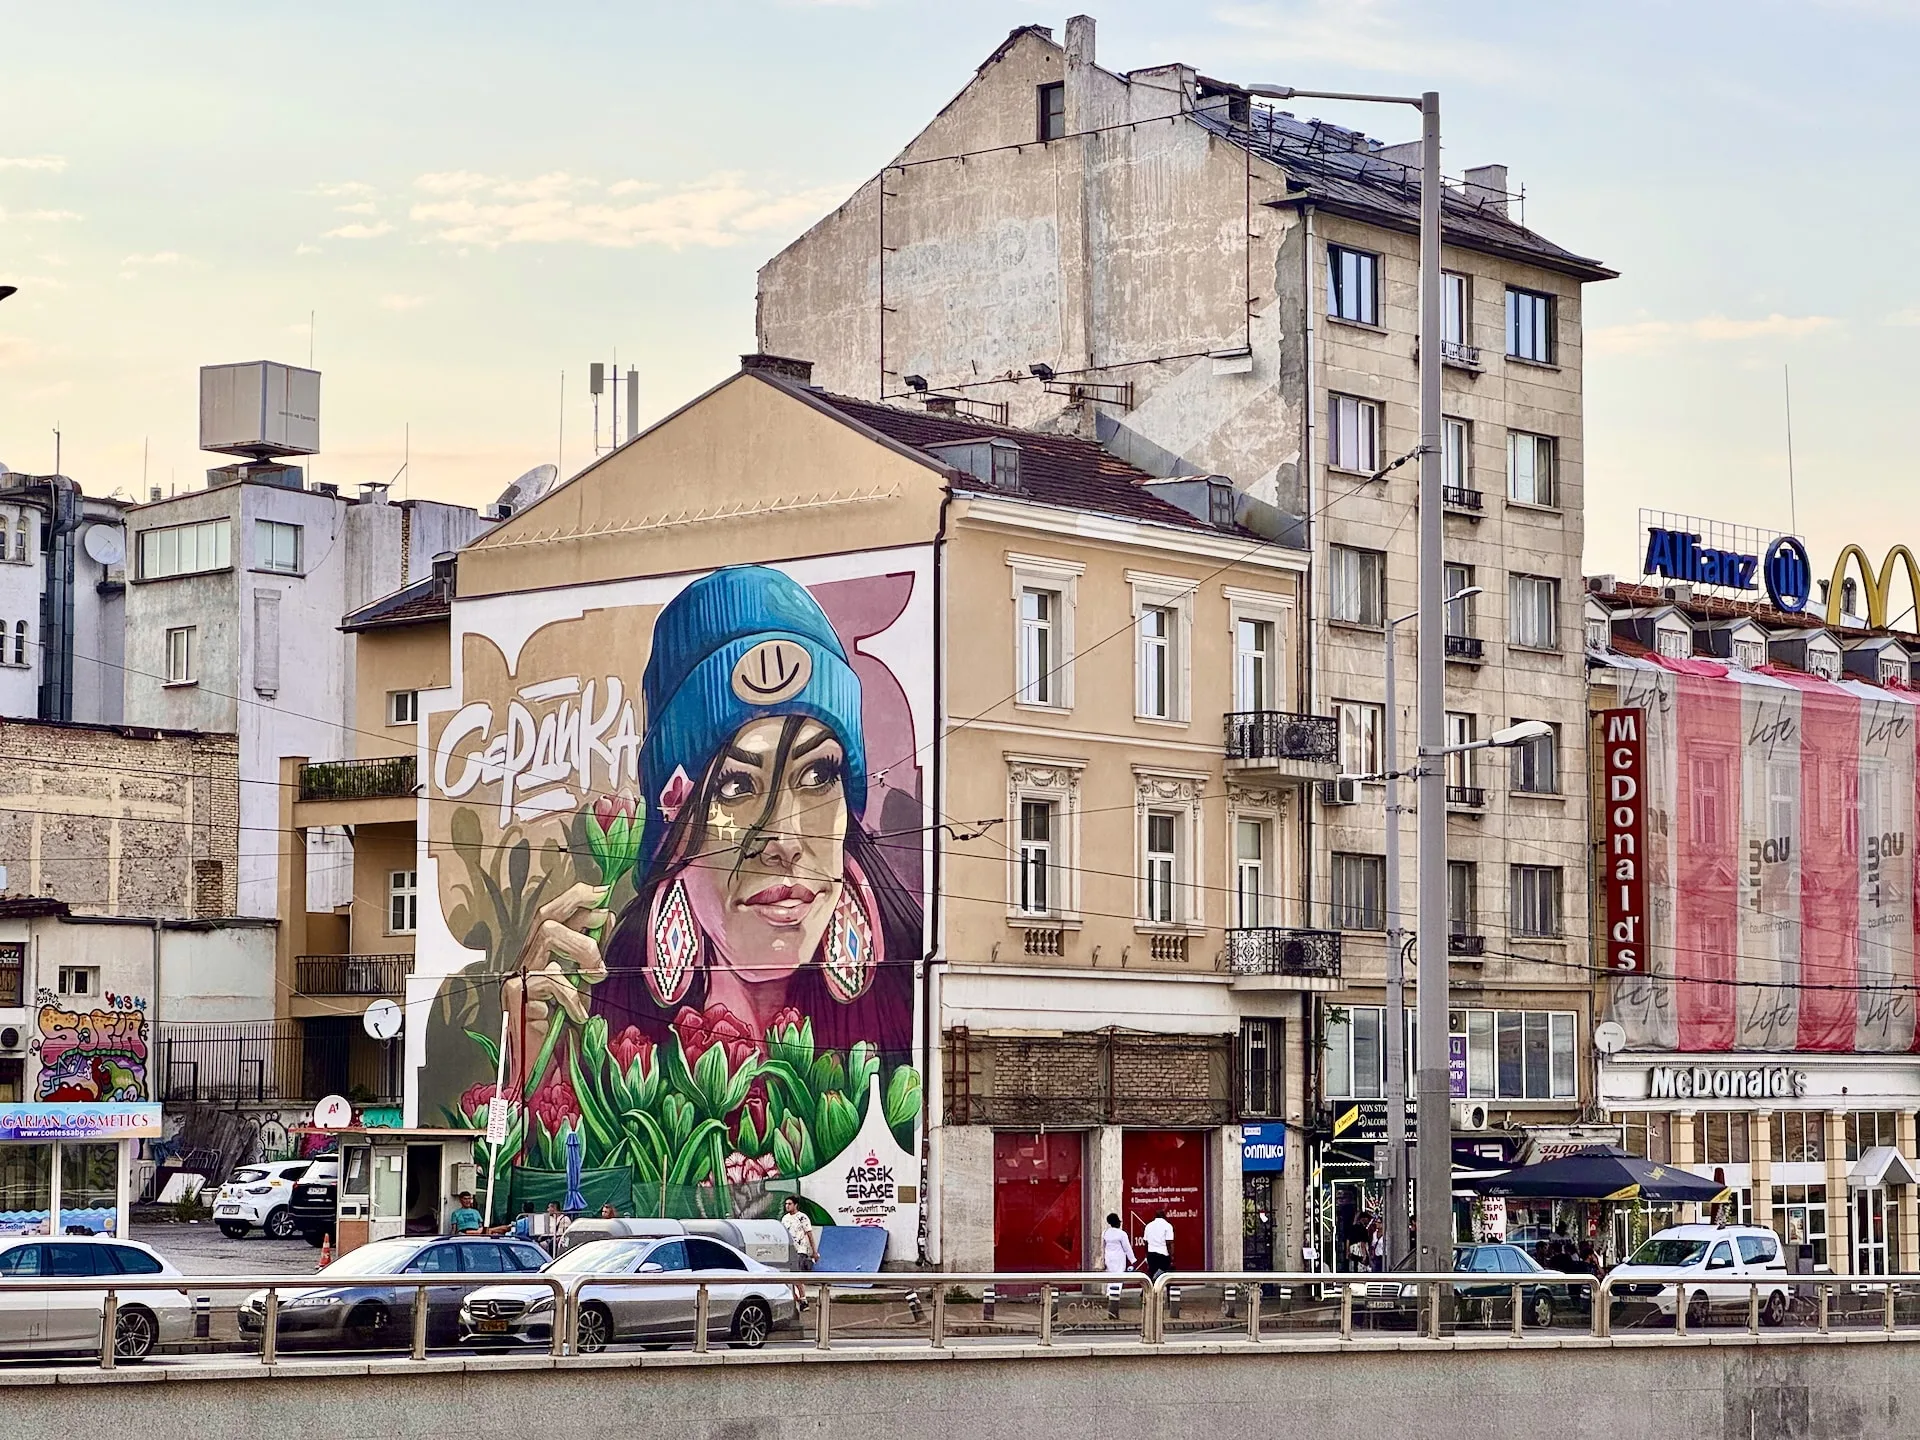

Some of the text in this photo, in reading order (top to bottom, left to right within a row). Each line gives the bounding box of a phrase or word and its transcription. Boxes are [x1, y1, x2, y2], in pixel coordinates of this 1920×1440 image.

[1643, 527, 1758, 590] Allianz
[1748, 695, 1795, 760] Life
[1866, 700, 1909, 757] Life
[1608, 716, 1640, 970] McDonald's
[1744, 981, 1793, 1047] Life
[1865, 973, 1909, 1037] Life
[1650, 1066, 1807, 1098] McDonald's
[1, 1113, 149, 1128] GARIAN COSMETICS
[1360, 1103, 1417, 1114] NON STO SH
[20, 1129, 103, 1138] www.contessabg.com
[1366, 1117, 1389, 1127] ALCOH
[846, 1165, 895, 1183] ARSEK
[846, 1184, 894, 1199] ERASE
[1484, 1213, 1498, 1221] SM
